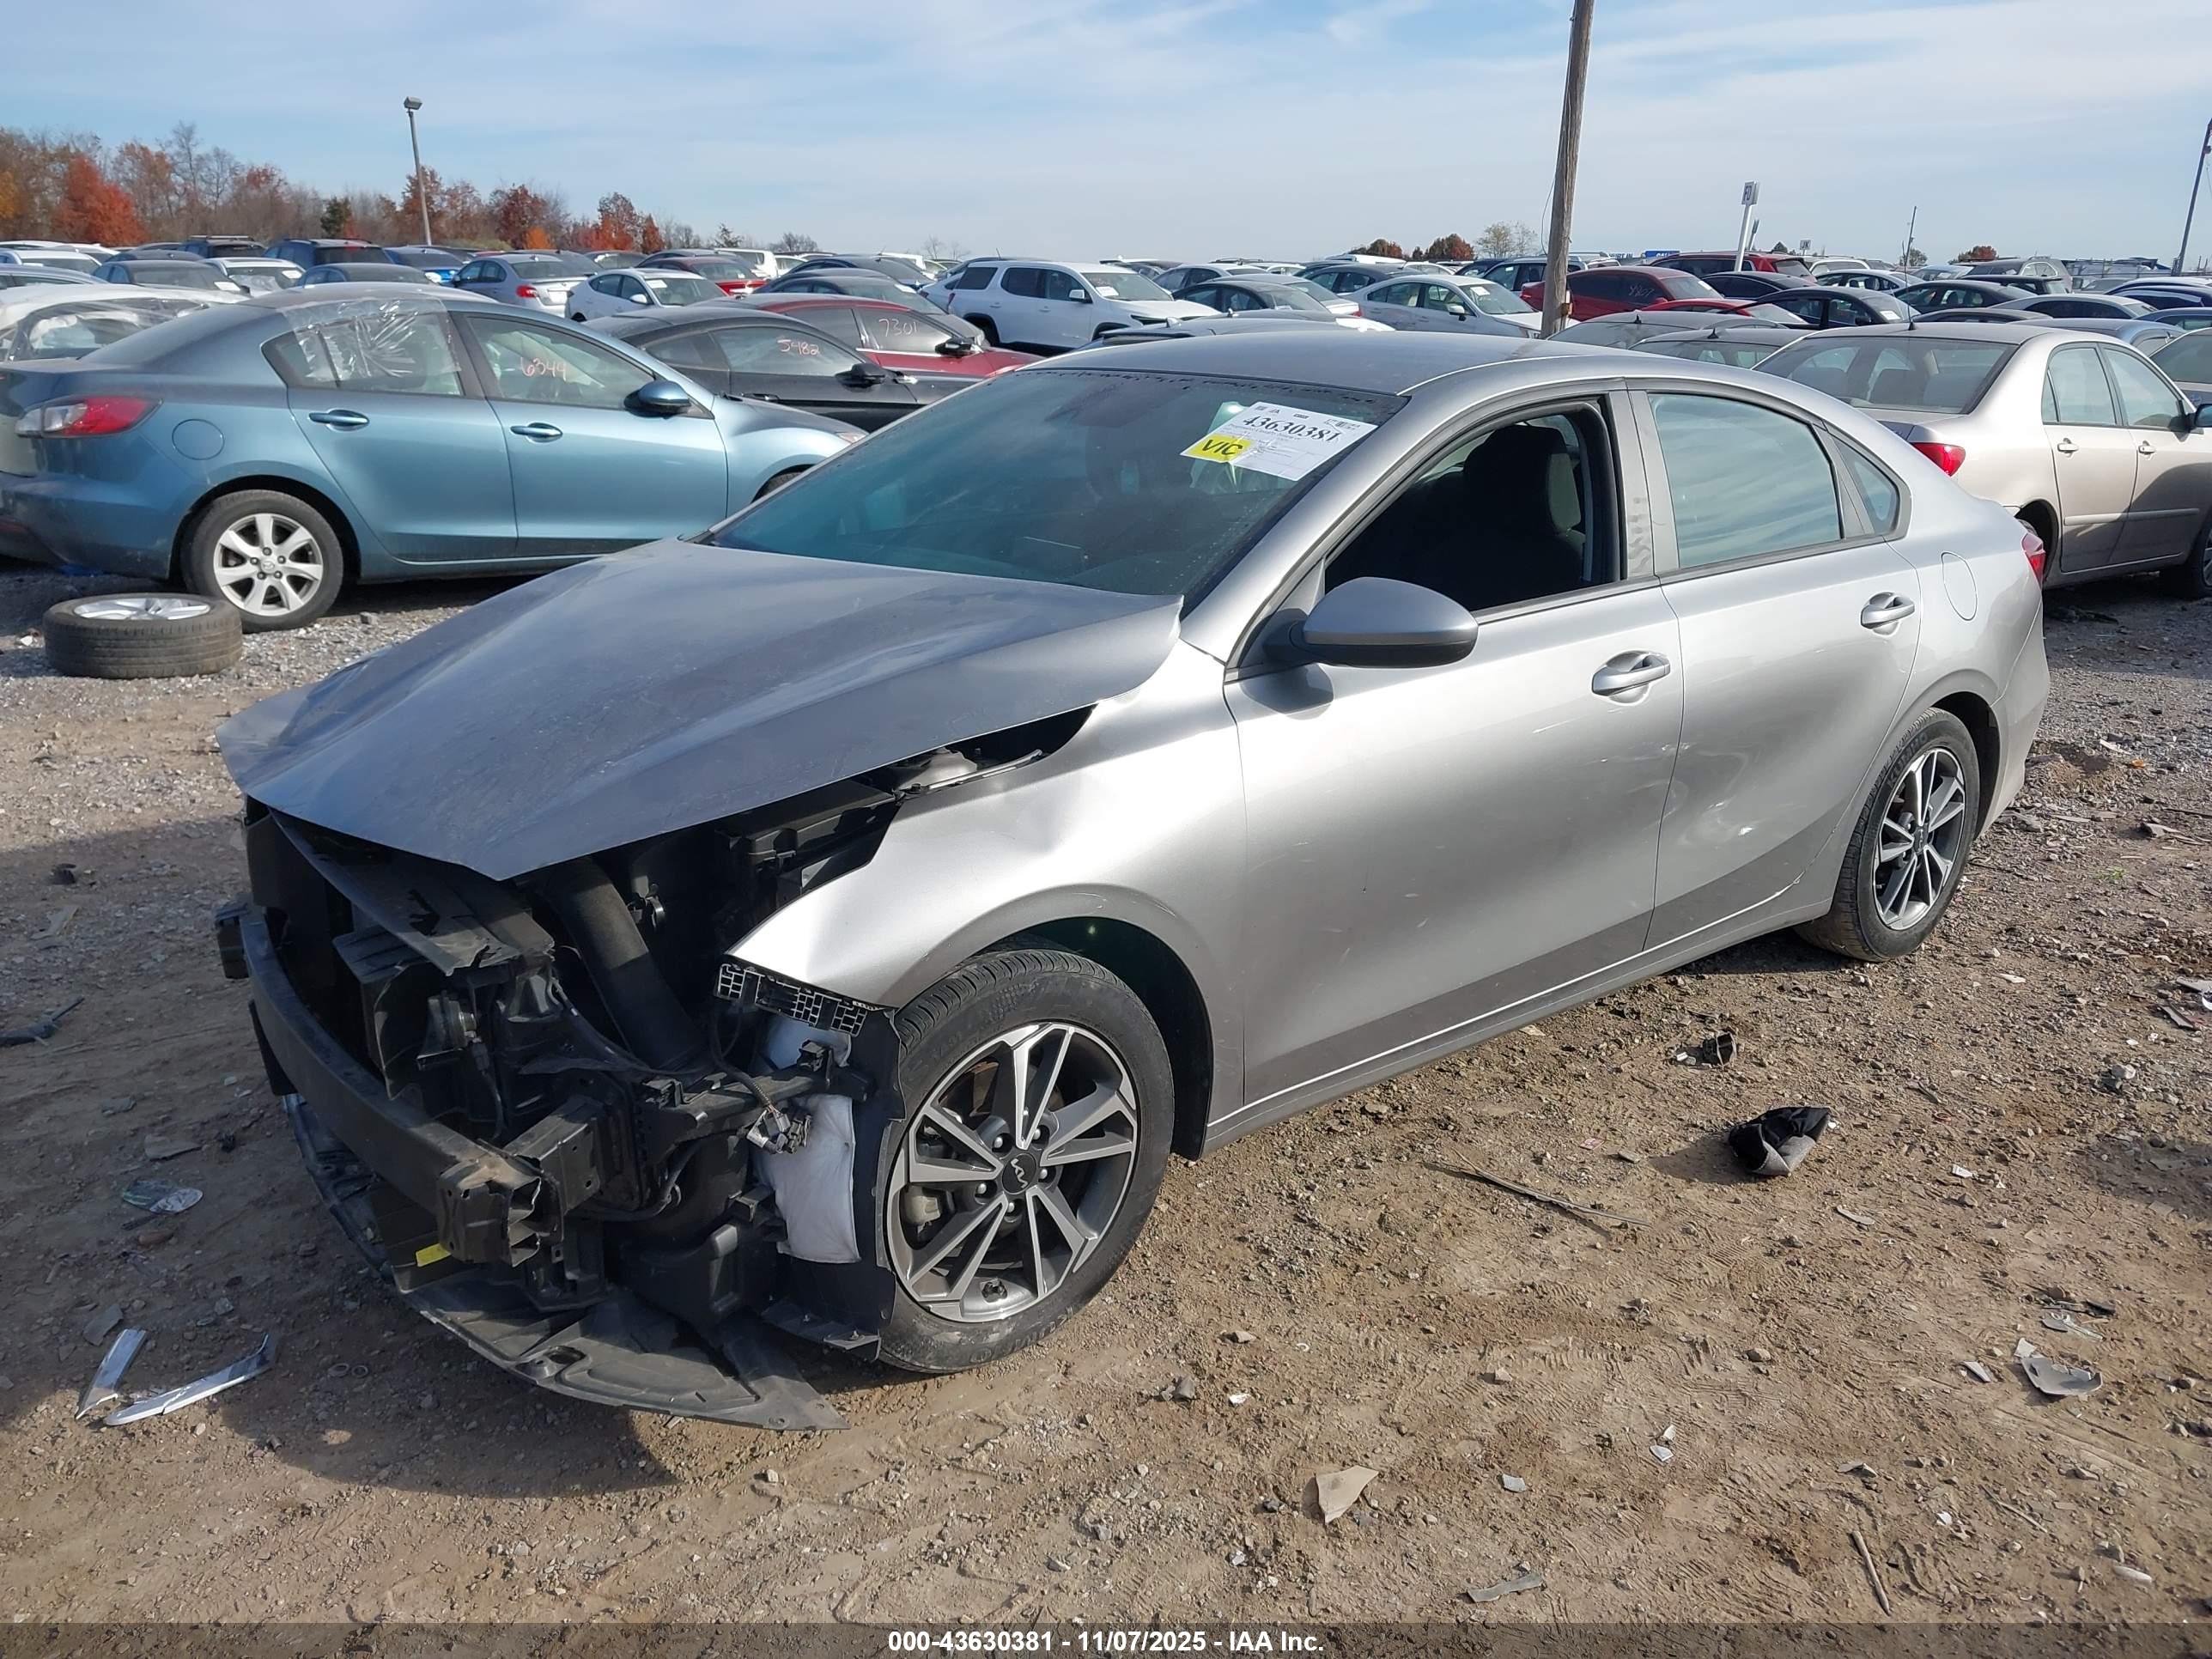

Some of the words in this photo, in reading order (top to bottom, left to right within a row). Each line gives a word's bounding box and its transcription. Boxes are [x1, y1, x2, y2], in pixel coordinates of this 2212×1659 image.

[878, 319, 917, 337] 7301
[520, 356, 567, 382] 6349
[1243, 416, 1341, 441] 43630381
[1202, 439, 1243, 455] VIC
